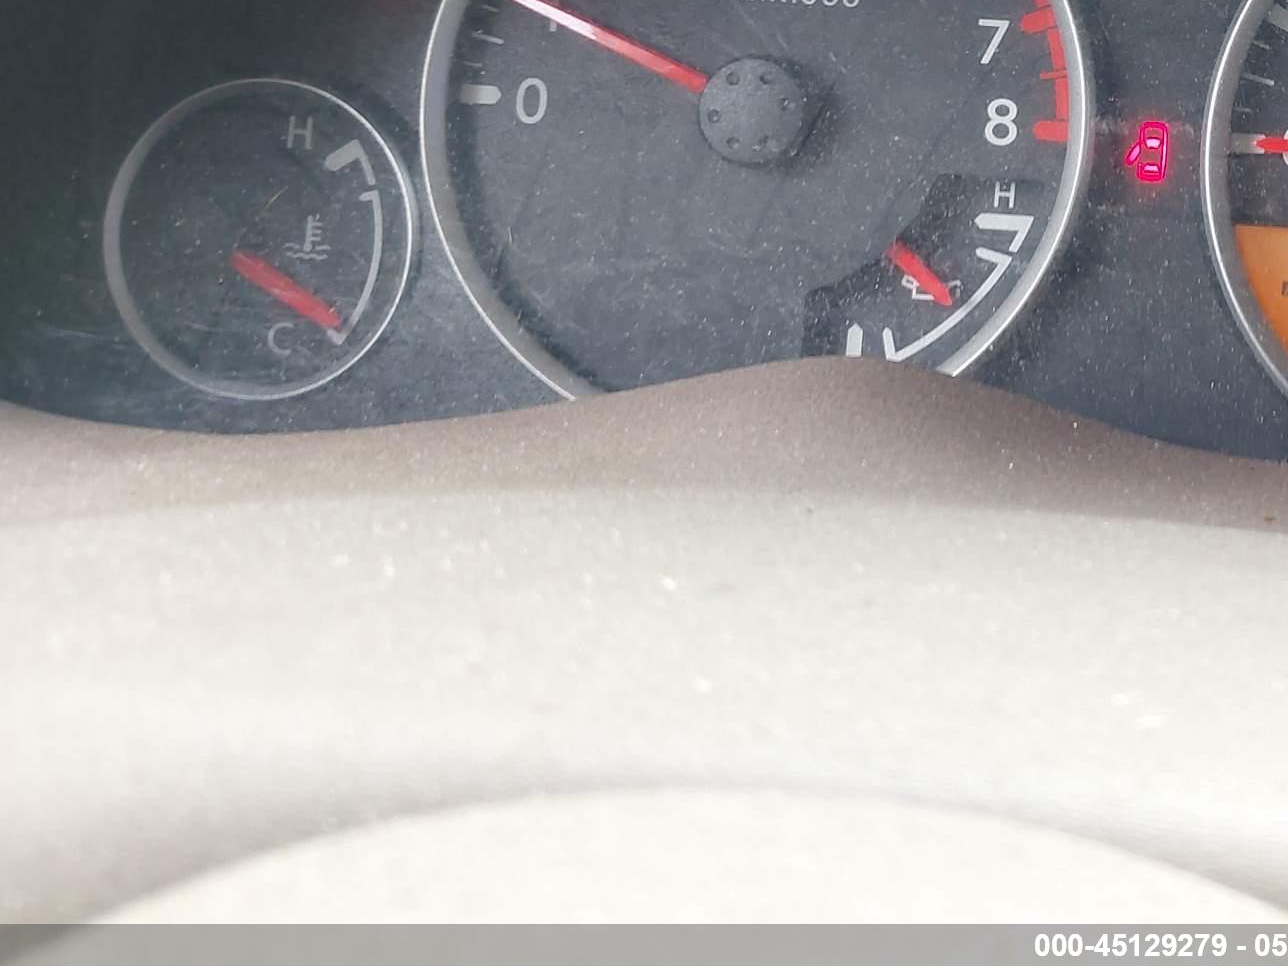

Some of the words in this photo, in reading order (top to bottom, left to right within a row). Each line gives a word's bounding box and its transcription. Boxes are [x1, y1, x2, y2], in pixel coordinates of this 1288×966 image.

[978, 18, 1010, 65] 7
[515, 77, 549, 125] 0
[286, 115, 314, 151] H
[984, 98, 1018, 146] 8
[993, 181, 1018, 209] H
[267, 322, 295, 355] C
